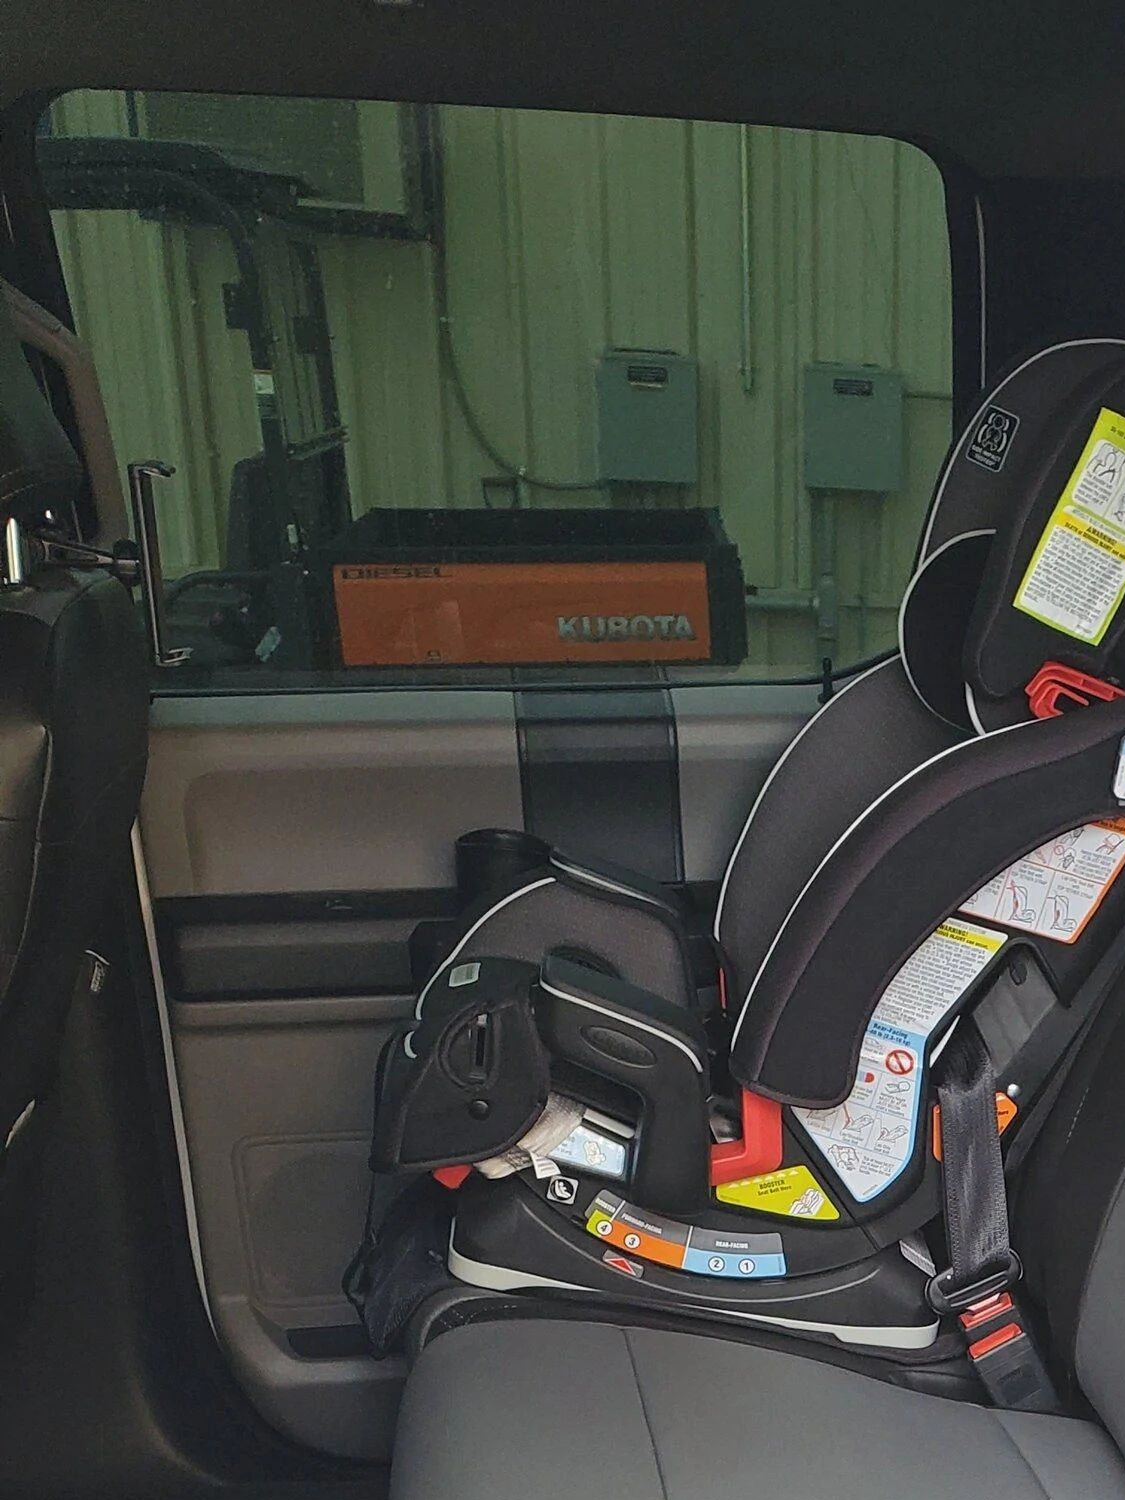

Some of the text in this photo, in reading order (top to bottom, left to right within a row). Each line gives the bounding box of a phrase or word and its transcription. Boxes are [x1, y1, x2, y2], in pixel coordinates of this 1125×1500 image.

[556, 615, 695, 642] KUBOTA
[939, 924, 969, 937] WARNING!
[759, 1180, 786, 1189] BOOSTER
[600, 1223, 608, 1233] 4
[628, 1237, 636, 1246] 3
[713, 1259, 720, 1268] 2
